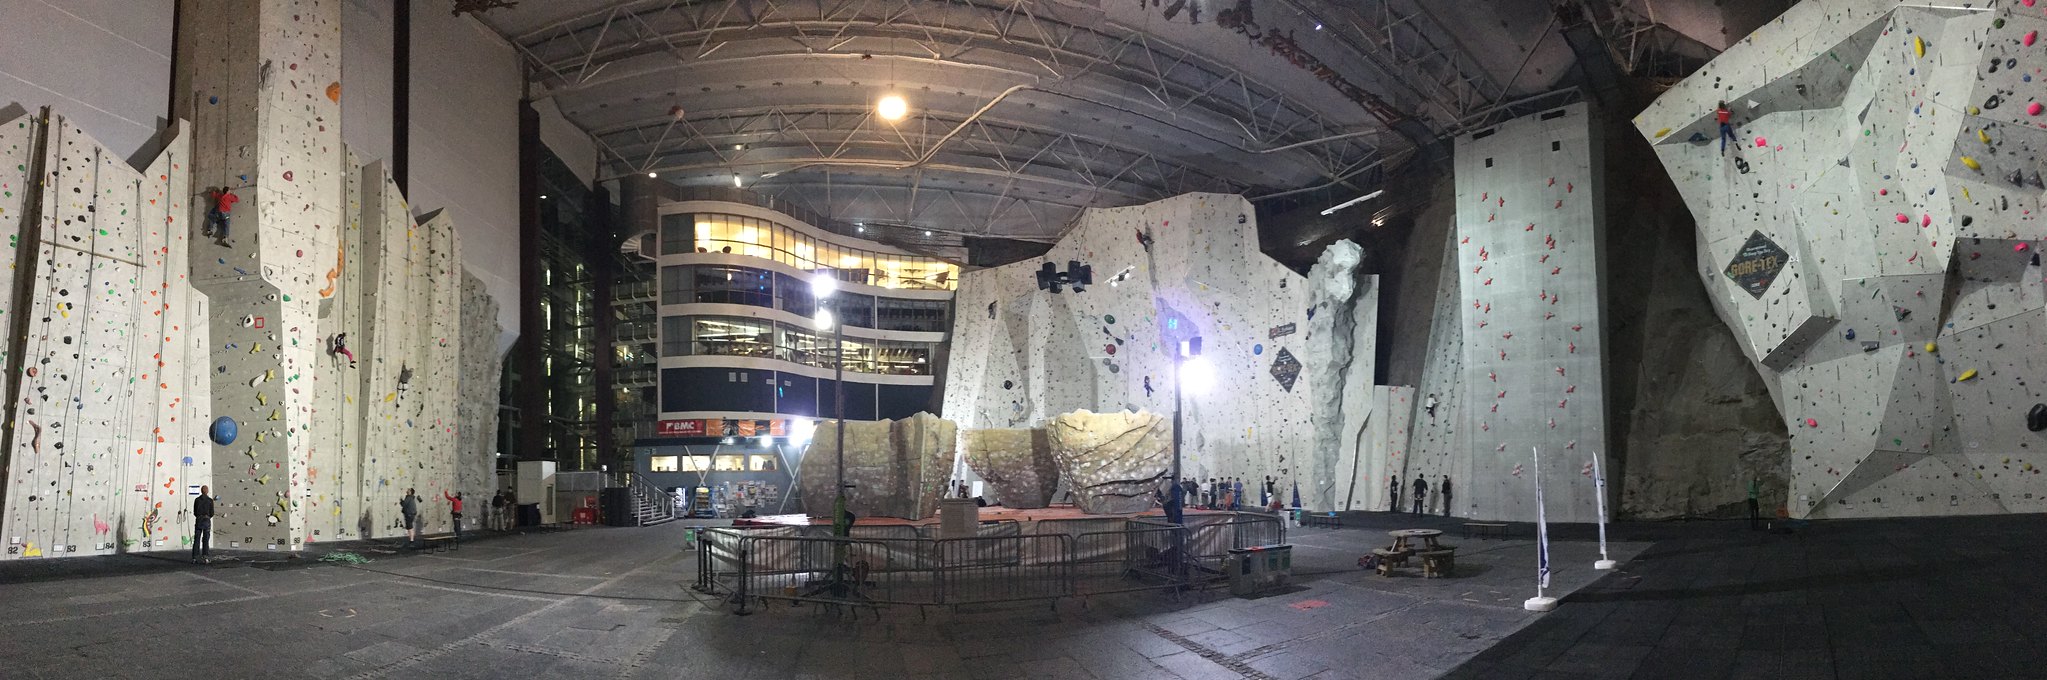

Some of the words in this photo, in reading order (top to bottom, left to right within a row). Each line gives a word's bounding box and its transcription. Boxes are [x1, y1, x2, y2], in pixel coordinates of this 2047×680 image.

[1731, 256, 1778, 276] GORE-TEX
[674, 421, 695, 430] BMC
[7, 546, 18, 554] 82
